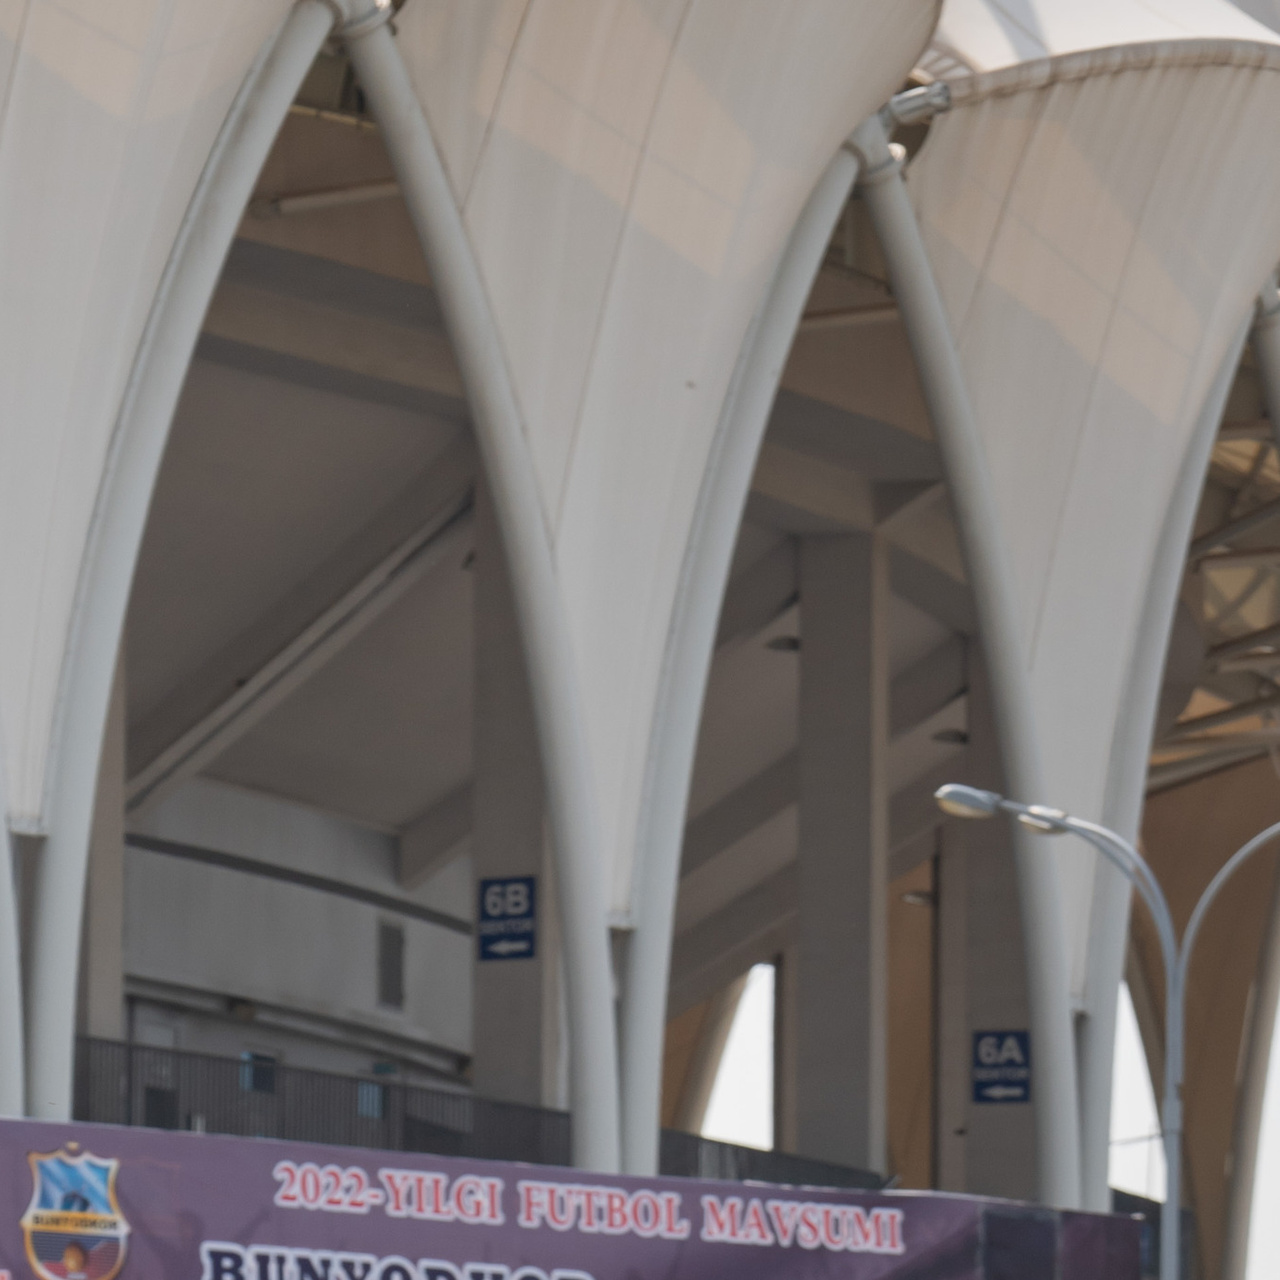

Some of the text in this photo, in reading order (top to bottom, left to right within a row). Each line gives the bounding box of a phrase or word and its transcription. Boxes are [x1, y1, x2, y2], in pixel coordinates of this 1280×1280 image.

[484, 882, 530, 917] 6B
[977, 1035, 1025, 1065] 6A
[273, 1161, 905, 1255] 2022-YILGI FUTBOL MAVSUMI
